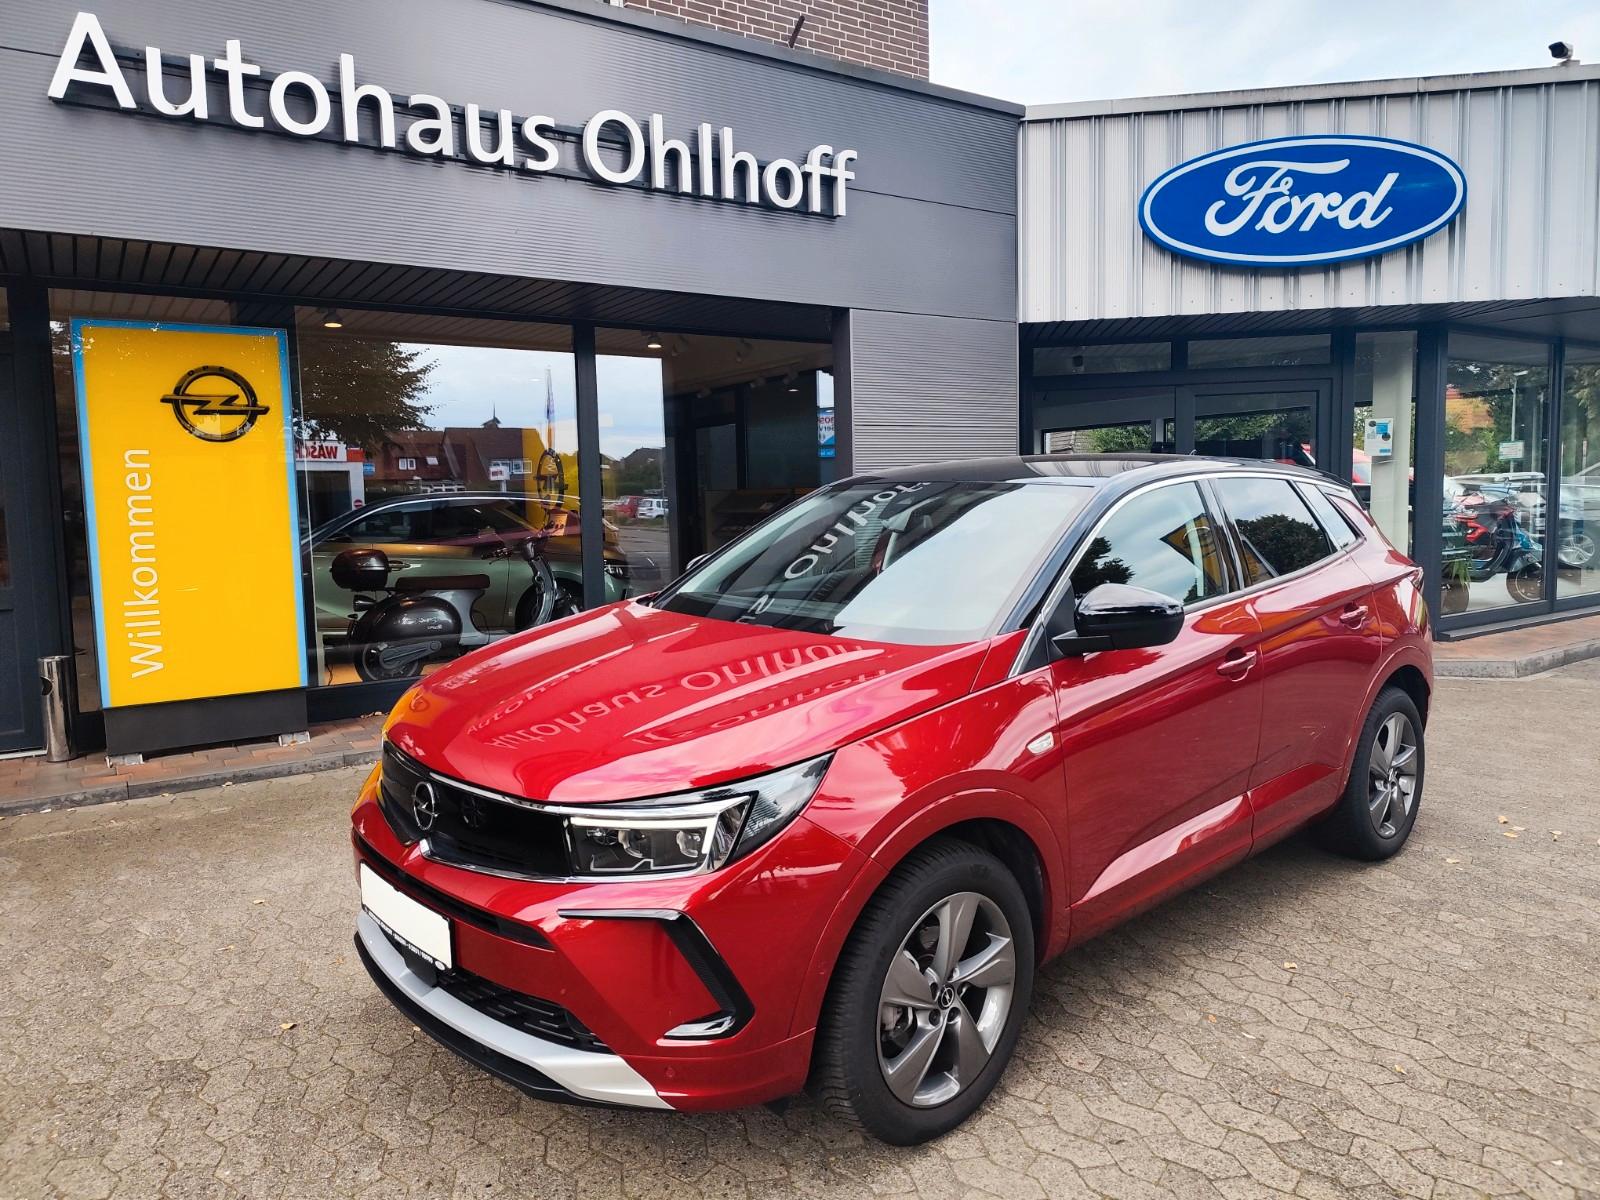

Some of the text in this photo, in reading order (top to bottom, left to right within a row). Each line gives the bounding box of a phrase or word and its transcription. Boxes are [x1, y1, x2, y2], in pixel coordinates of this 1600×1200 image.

[48, 11, 858, 217] Autohaus Ohlhoff
[1204, 158, 1400, 237] Ford
[123, 448, 165, 679] Willkommen
